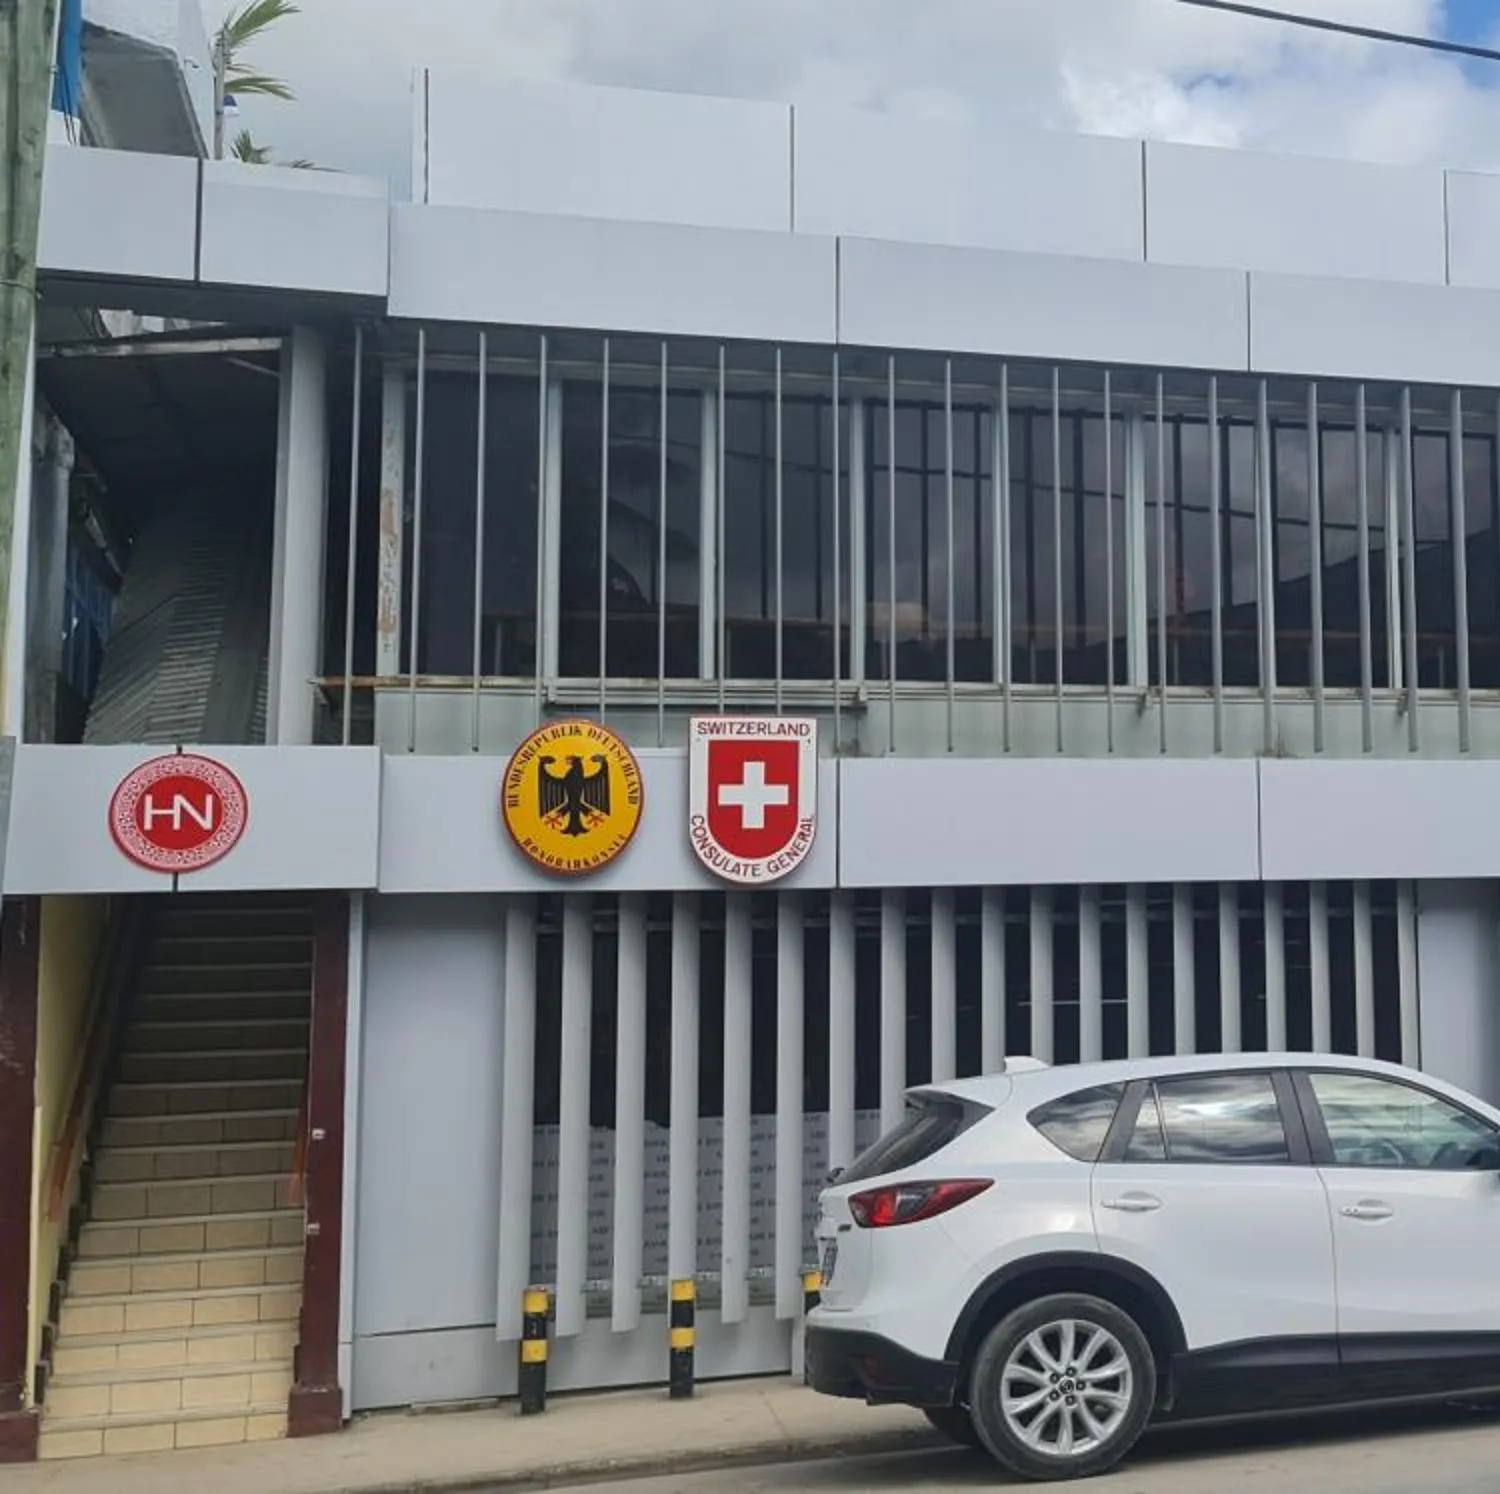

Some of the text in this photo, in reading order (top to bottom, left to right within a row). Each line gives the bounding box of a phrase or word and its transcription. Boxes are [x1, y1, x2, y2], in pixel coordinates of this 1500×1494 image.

[697, 721, 811, 737] SWITZERLAND
[143, 794, 214, 831] HN
[691, 814, 816, 877] CONSULATE GENERAL
